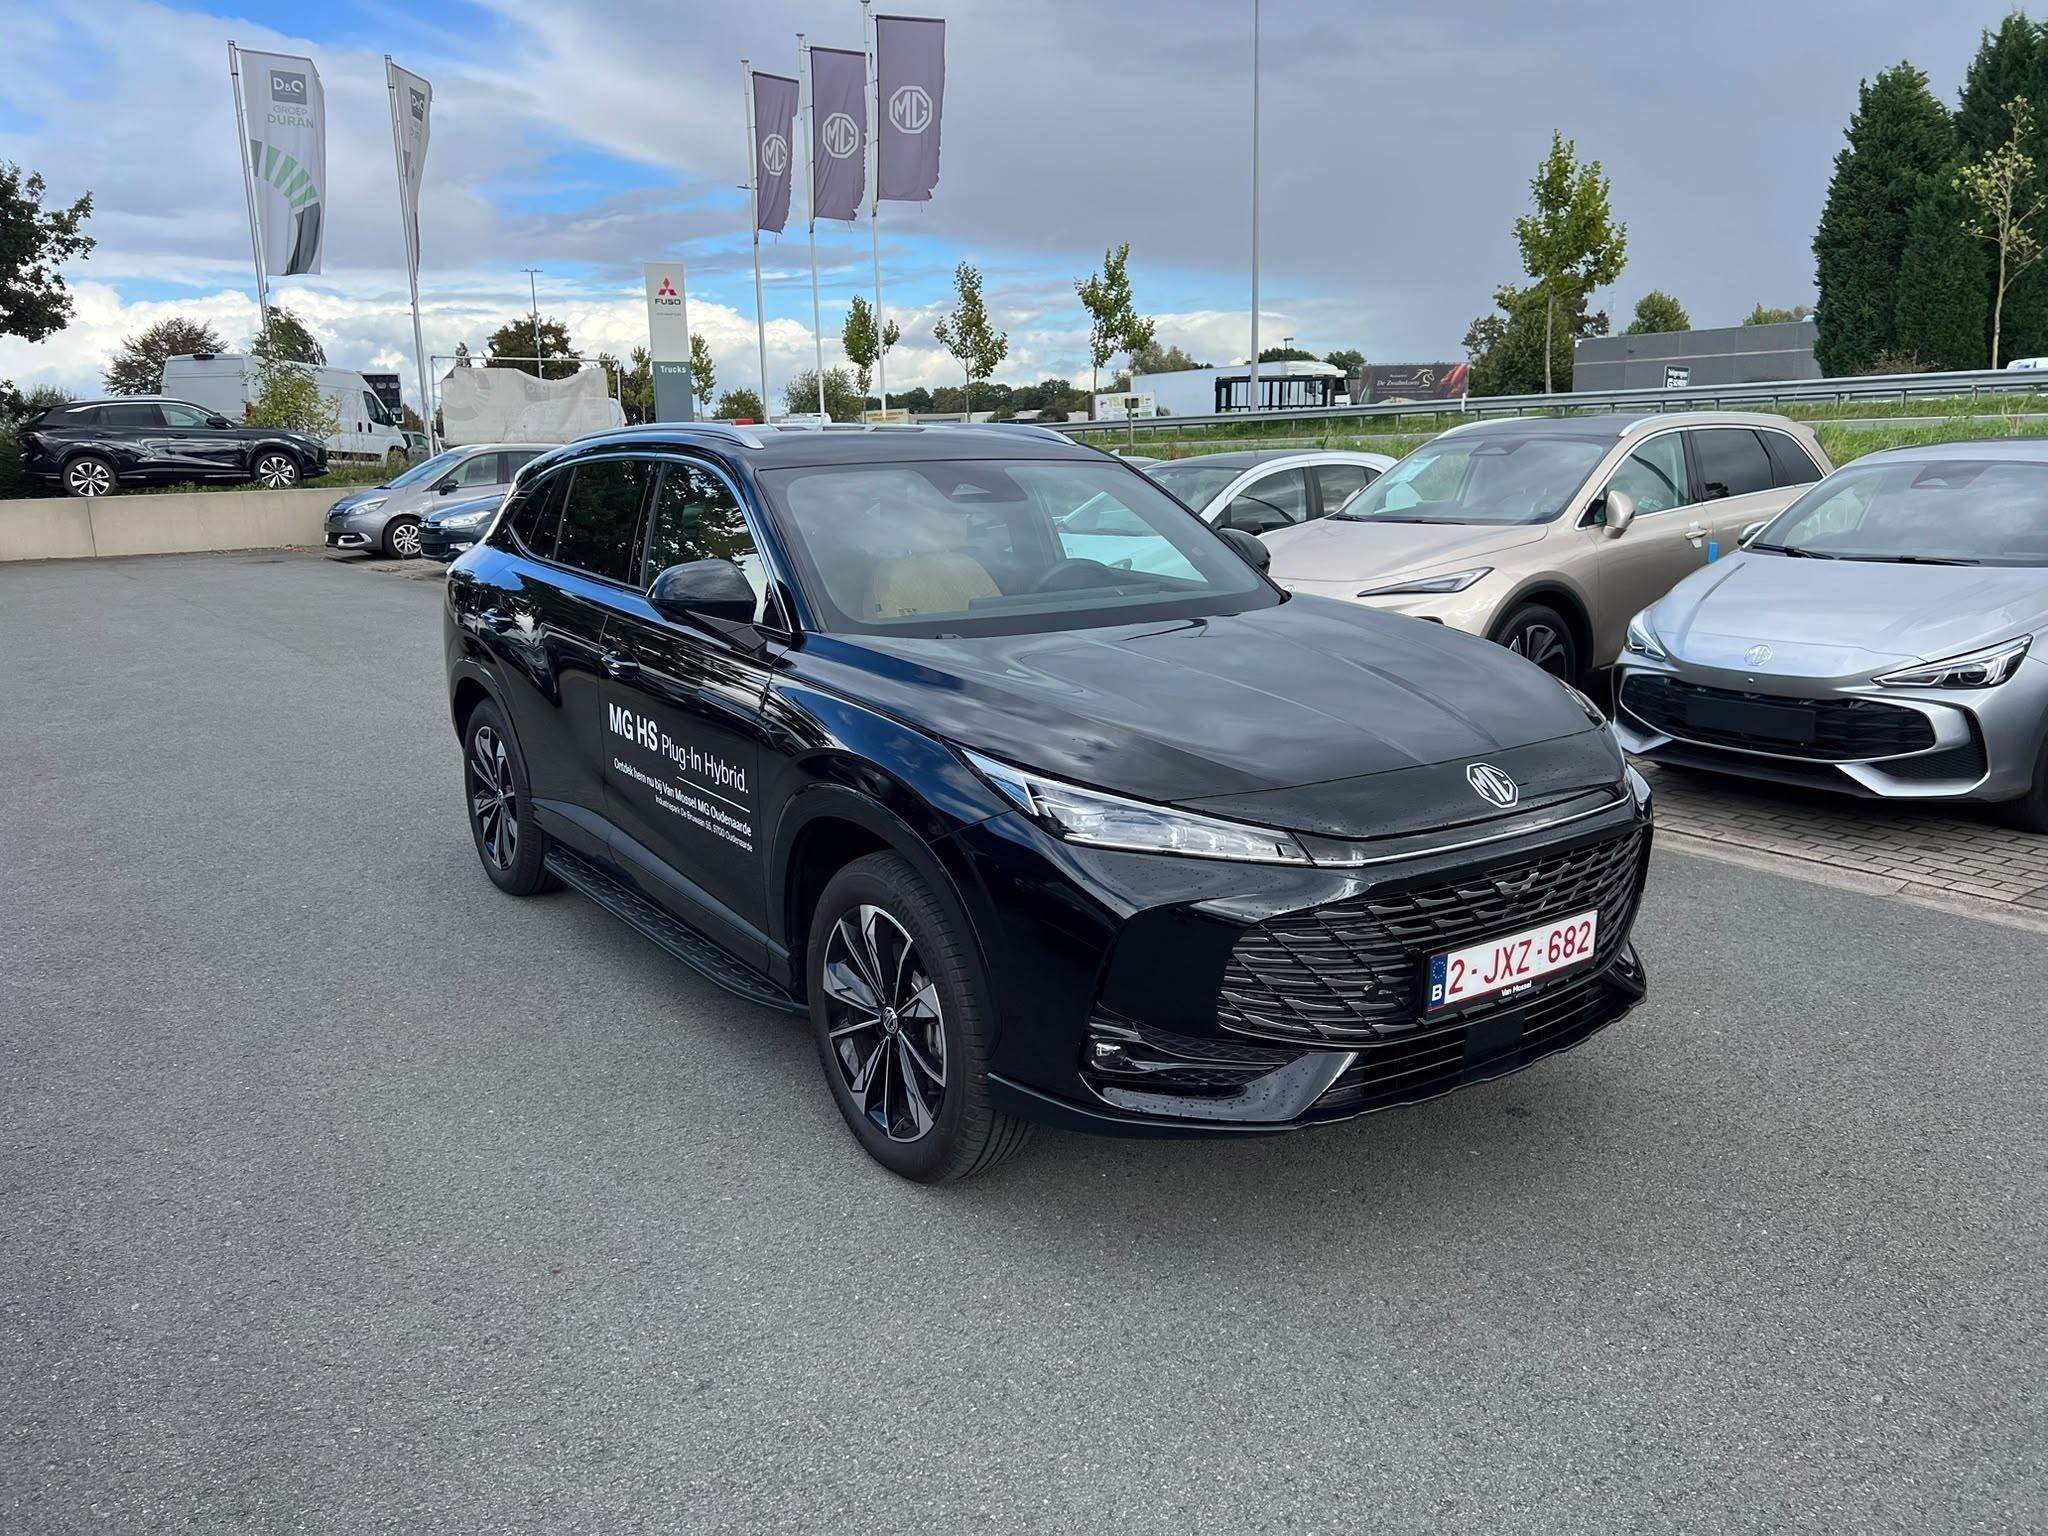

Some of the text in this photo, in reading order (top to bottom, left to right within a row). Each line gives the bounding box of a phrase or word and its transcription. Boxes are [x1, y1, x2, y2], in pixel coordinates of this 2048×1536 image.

[267, 113, 314, 129] DURAN
[273, 104, 308, 115] GROEP
[893, 90, 929, 130] MG
[825, 116, 855, 155] MG
[764, 137, 787, 172] MG
[654, 298, 681, 306] FUSO
[660, 365, 687, 374] Trucks
[608, 702, 749, 794] MG HS Plug-In Hybrid.
[614, 757, 752, 837] Ontdek hem nu bij Van Mossel MG Oudenaarde
[1470, 765, 1515, 803] MG
[725, 830, 753, 852] Oudenaarde
[1448, 920, 1591, 995] 2-JXZ-682
[1432, 983, 1443, 1001] B
[1501, 980, 1532, 997] Van Mossel
